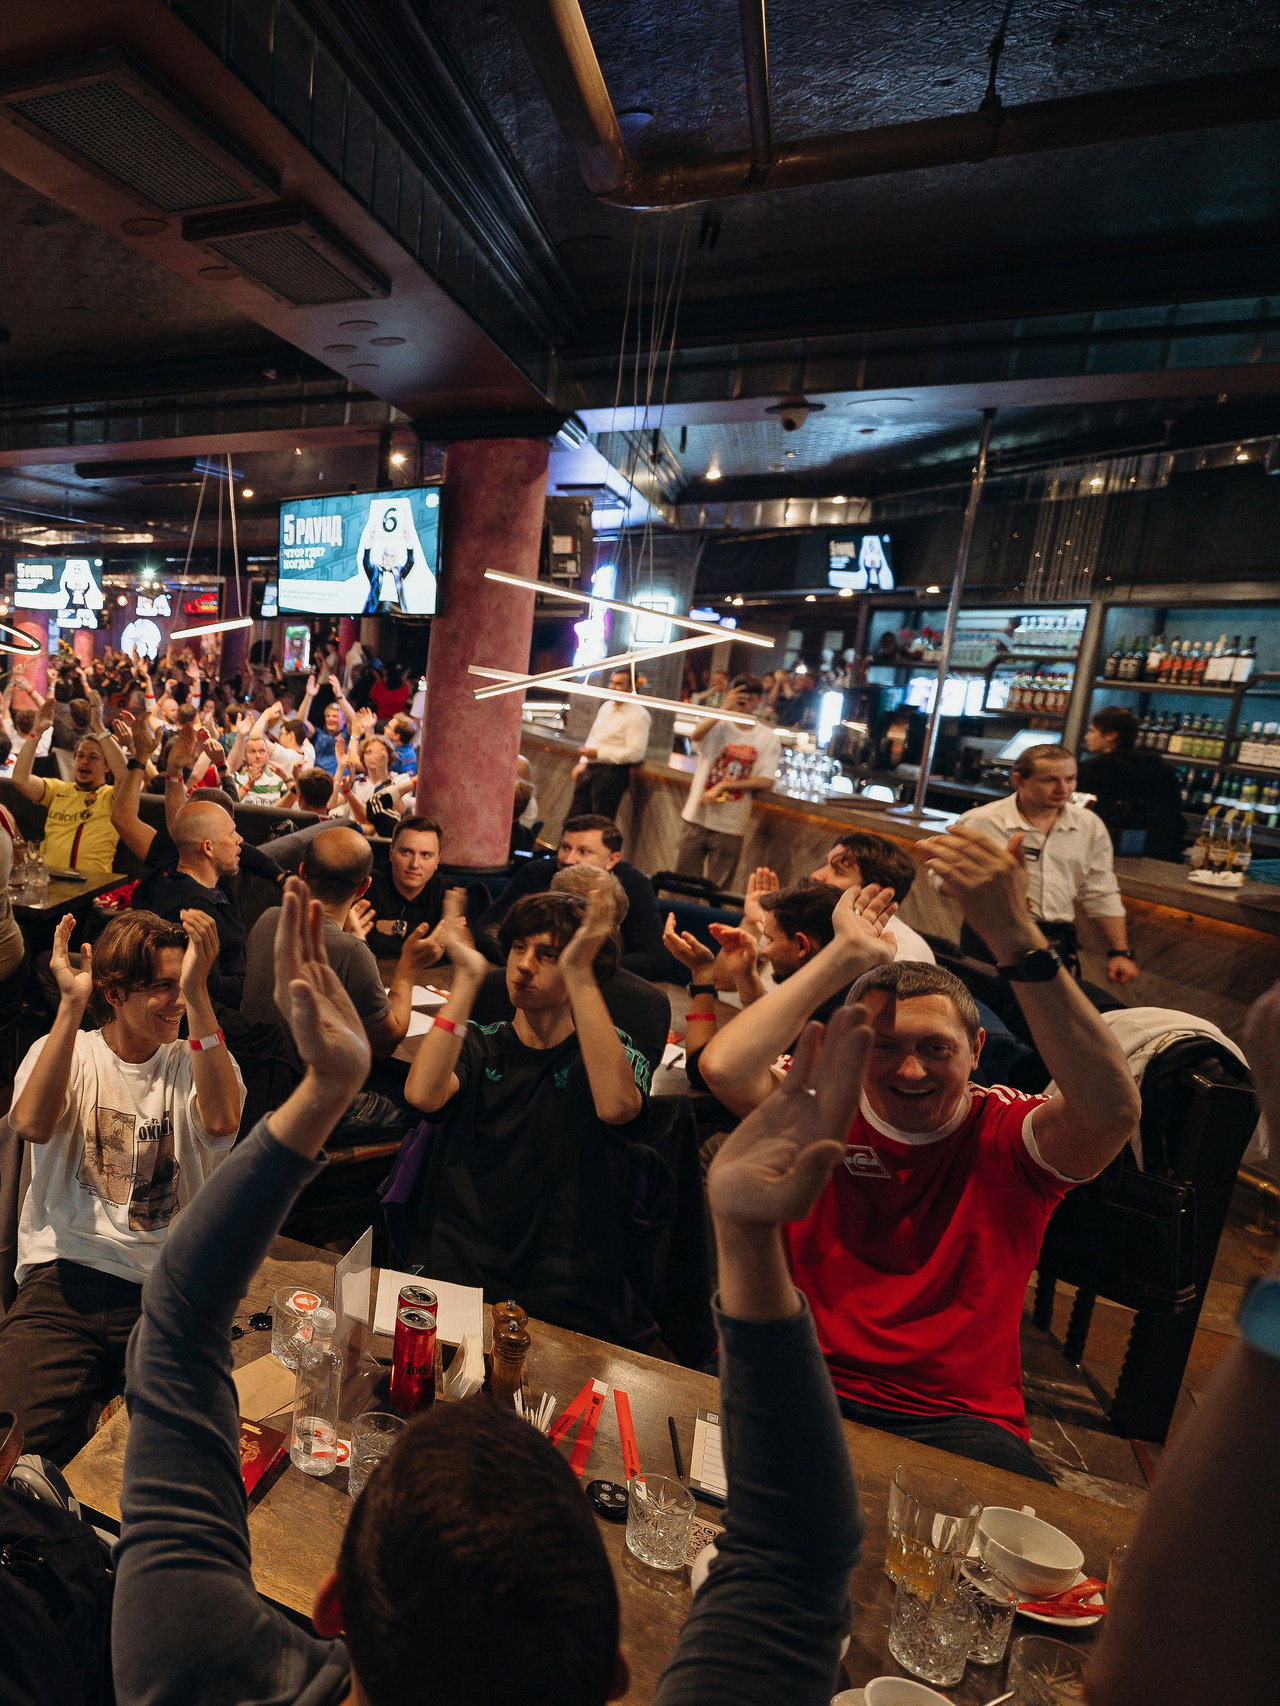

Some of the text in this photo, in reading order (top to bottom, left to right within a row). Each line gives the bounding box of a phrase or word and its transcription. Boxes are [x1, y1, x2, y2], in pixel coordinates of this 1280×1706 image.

[283, 514, 343, 547] 5 РАУНД
[381, 507, 399, 533] 6
